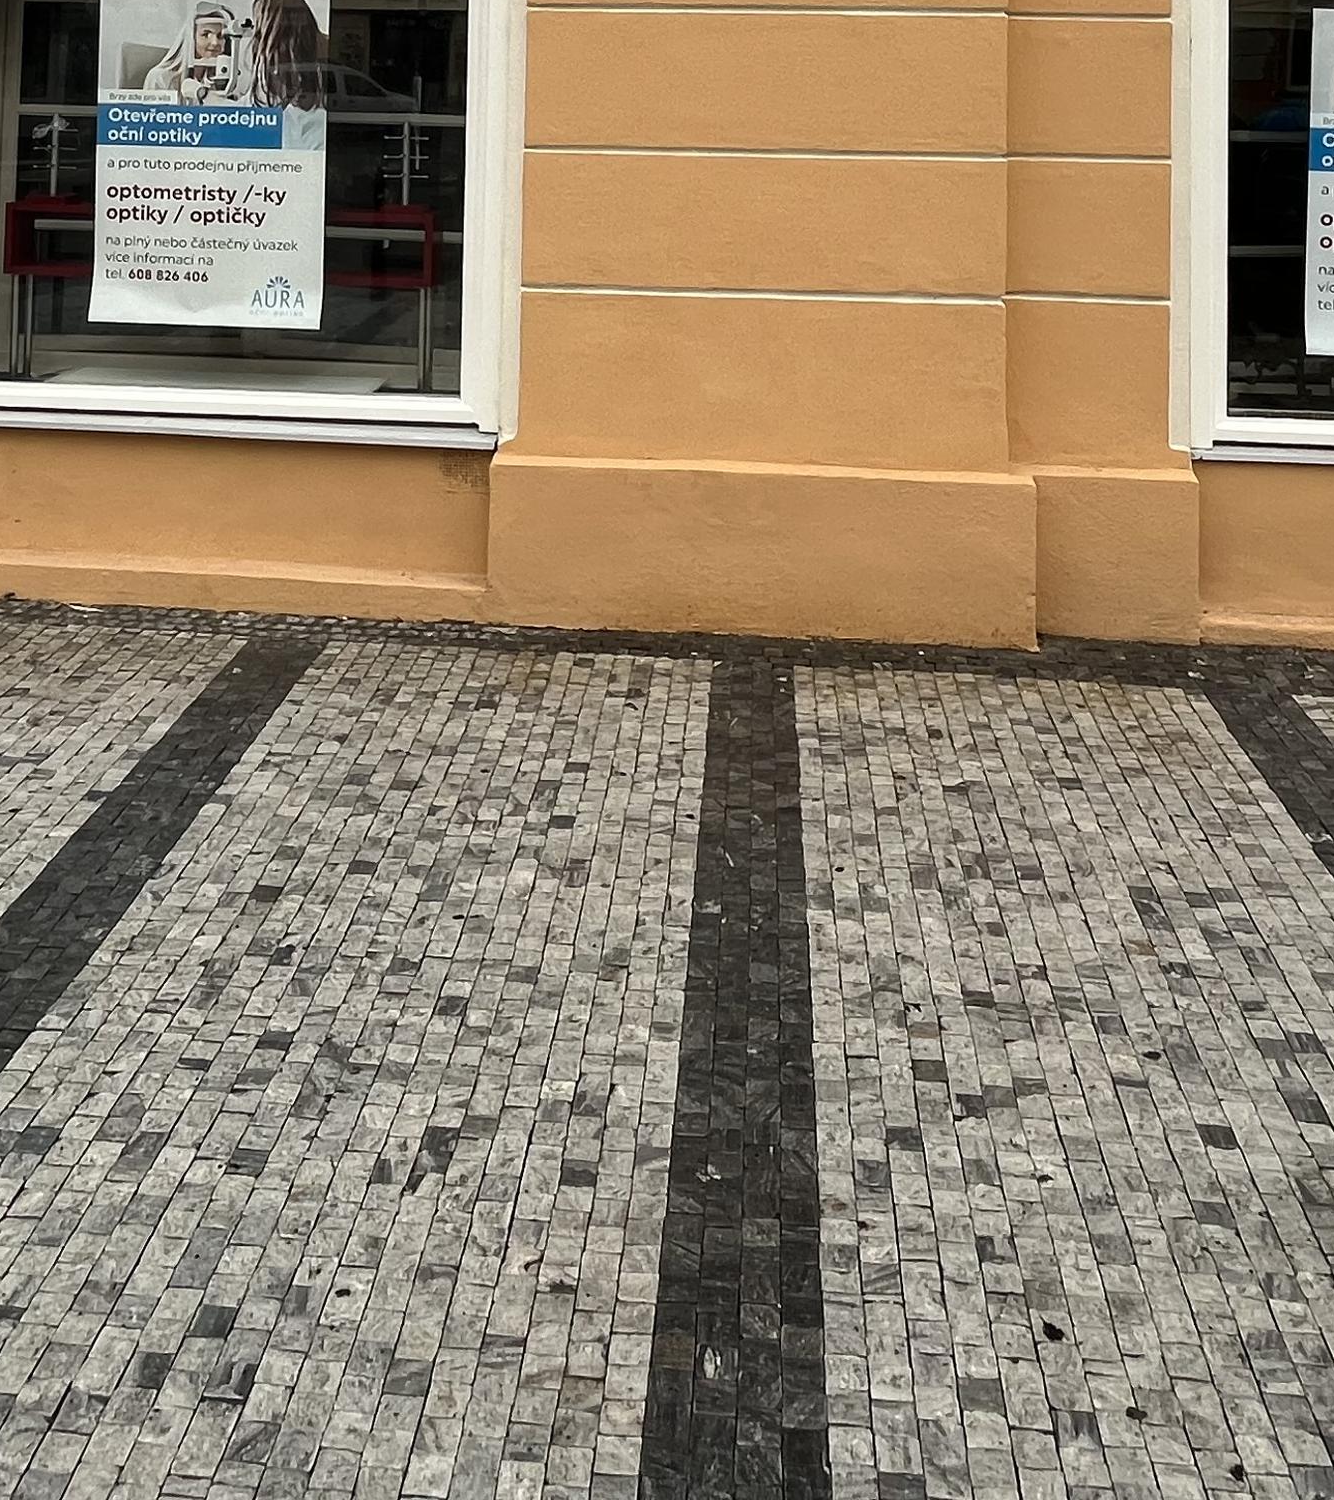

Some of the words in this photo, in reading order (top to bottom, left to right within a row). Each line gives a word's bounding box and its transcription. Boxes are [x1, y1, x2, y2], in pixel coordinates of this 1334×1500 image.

[108, 107, 194, 124] Otevřeme
[198, 110, 277, 129] prodejnu
[108, 126, 143, 142] oční
[148, 128, 203, 146] optiky
[107, 160, 115, 168] a
[118, 160, 141, 171] pro
[144, 158, 171, 170] tuto
[173, 159, 234, 173] prodejnu
[107, 184, 237, 204] optometristy
[243, 184, 287, 206] /-ky
[1321, 185, 1329, 196] a
[107, 204, 169, 225] optiky
[173, 205, 185, 224] /
[190, 206, 267, 228] optičky
[105, 236, 121, 246] na
[124, 236, 149, 250] plný
[154, 236, 187, 248] nebo
[191, 238, 249, 252] částečný
[253, 239, 299, 252] úvazek
[105, 252, 131, 263] více
[133, 253, 195, 266] informací
[198, 257, 213, 266] na
[128, 268, 152, 280] 608
[156, 270, 179, 282] 826
[183, 270, 209, 282] 406
[1318, 266, 1334, 276] na
[251, 290, 305, 309] AURA
